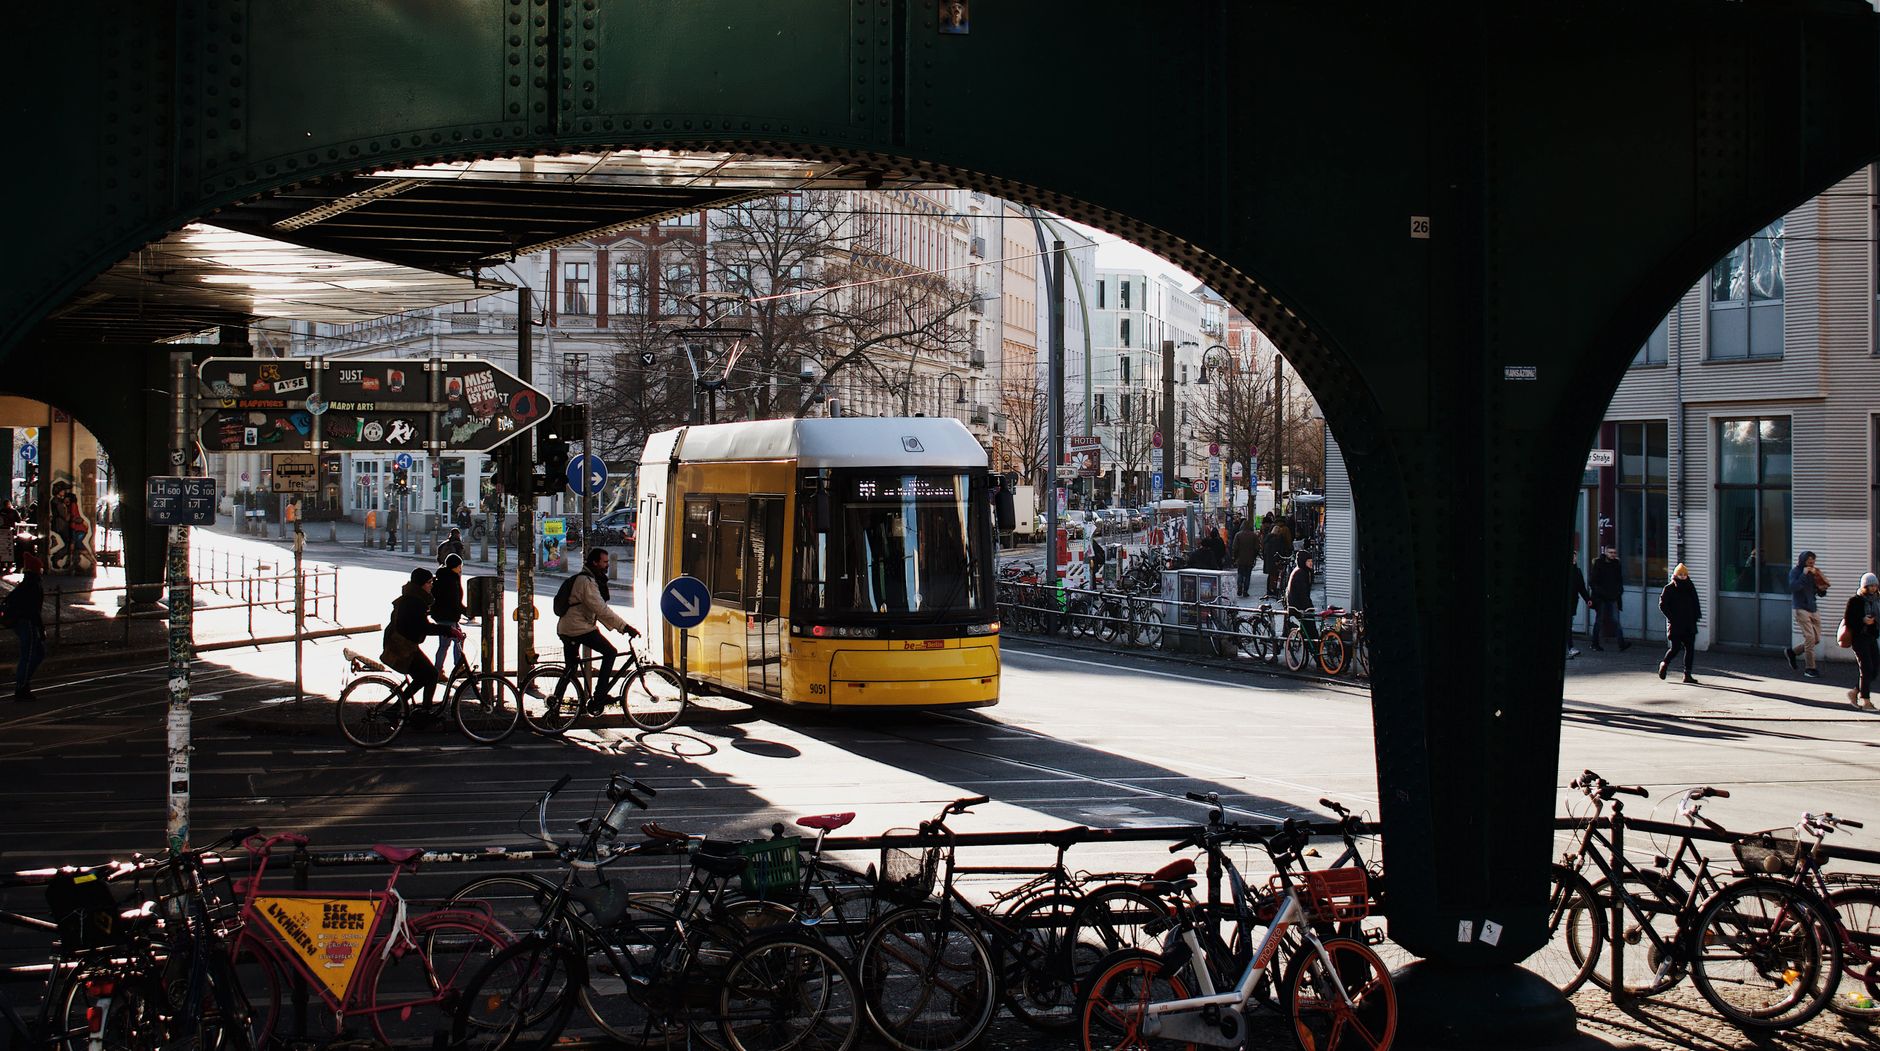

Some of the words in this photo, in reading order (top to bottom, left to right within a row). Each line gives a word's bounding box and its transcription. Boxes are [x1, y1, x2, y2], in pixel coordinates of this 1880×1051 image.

[1413, 221, 1428, 233] 26
[340, 370, 363, 380] JUST
[464, 370, 494, 387] MISS
[330, 401, 354, 410] MARDY
[357, 402, 374, 411] ARTS
[150, 484, 165, 495] LH
[184, 484, 200, 496] VS
[202, 488, 214, 496] 100
[1195, 482, 1203, 490] 30
[810, 683, 826, 694] 9051
[323, 904, 348, 912] DER
[322, 921, 364, 929] WEGEN
[1259, 927, 1282, 964] mobike
